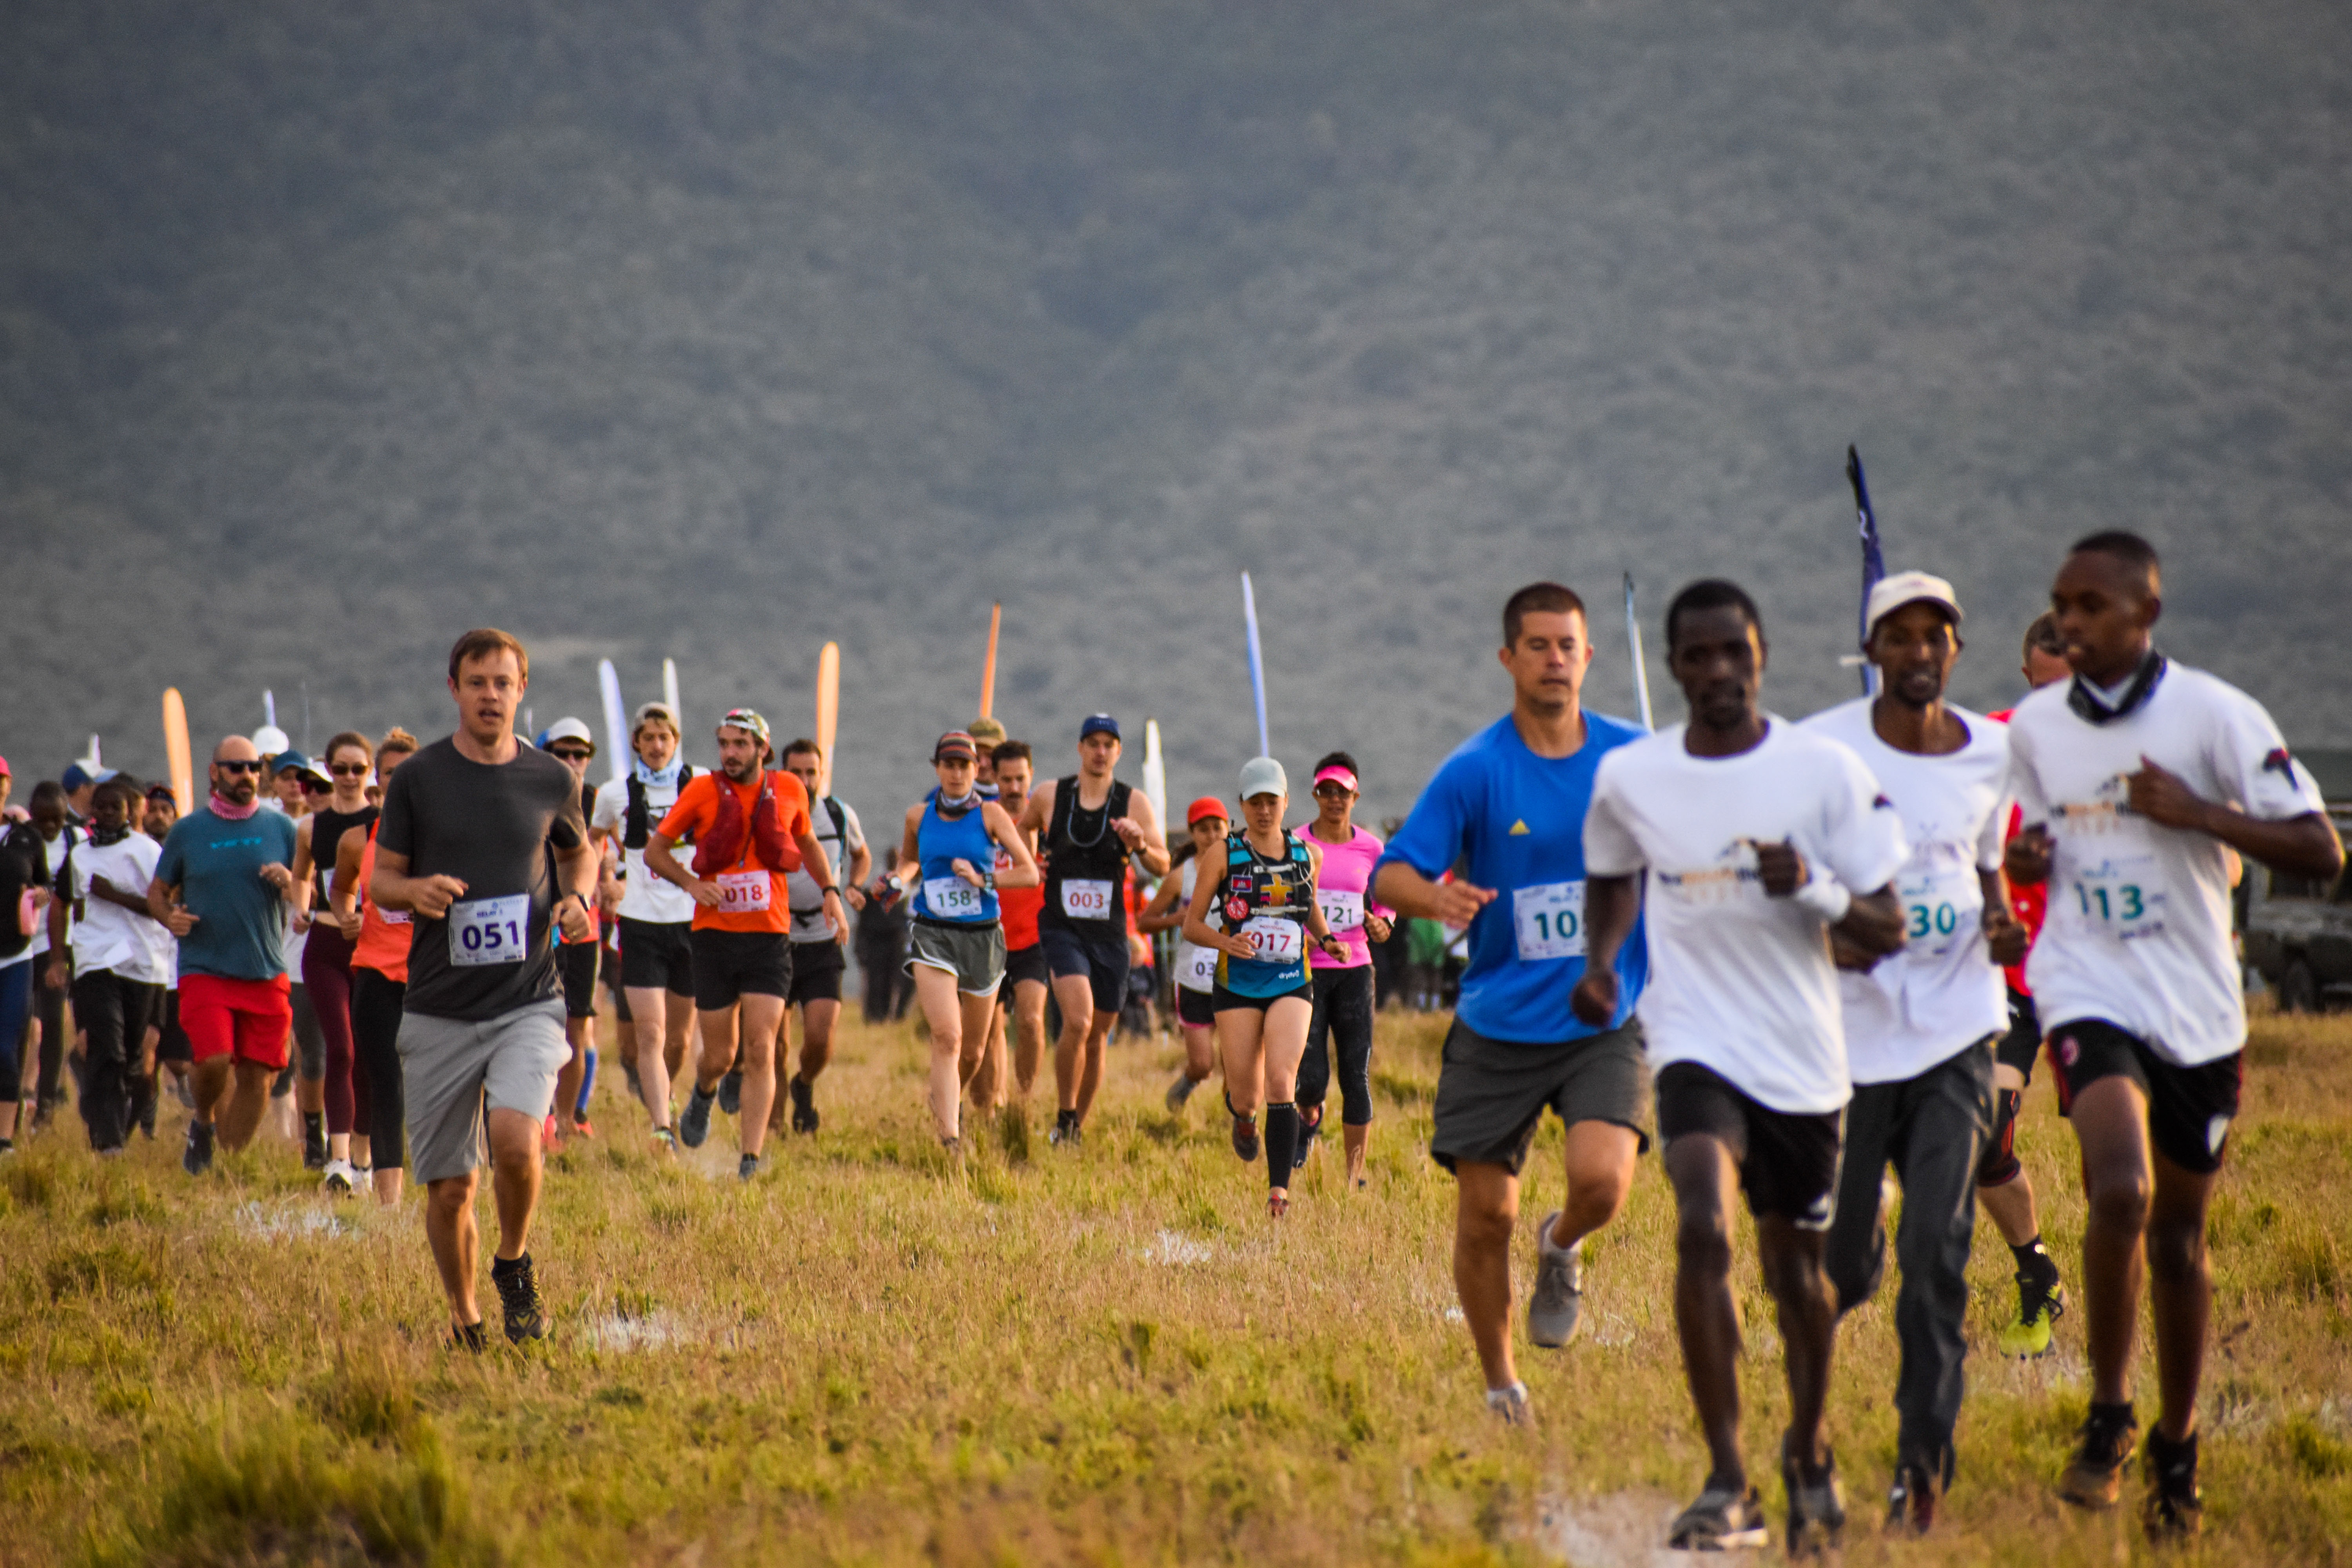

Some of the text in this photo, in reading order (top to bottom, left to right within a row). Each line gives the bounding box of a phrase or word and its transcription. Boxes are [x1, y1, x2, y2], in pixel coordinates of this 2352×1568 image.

[725, 884, 763, 903] 018
[937, 890, 971, 907] 158
[1070, 893, 1103, 909] 003
[2074, 880, 2144, 920] 113
[1322, 906, 1352, 924] 121
[1534, 910, 1578, 940] 10
[1909, 901, 1956, 938] 30
[462, 920, 519, 951] 051
[1251, 931, 1291, 952] 017
[1195, 961, 1217, 976] 03
